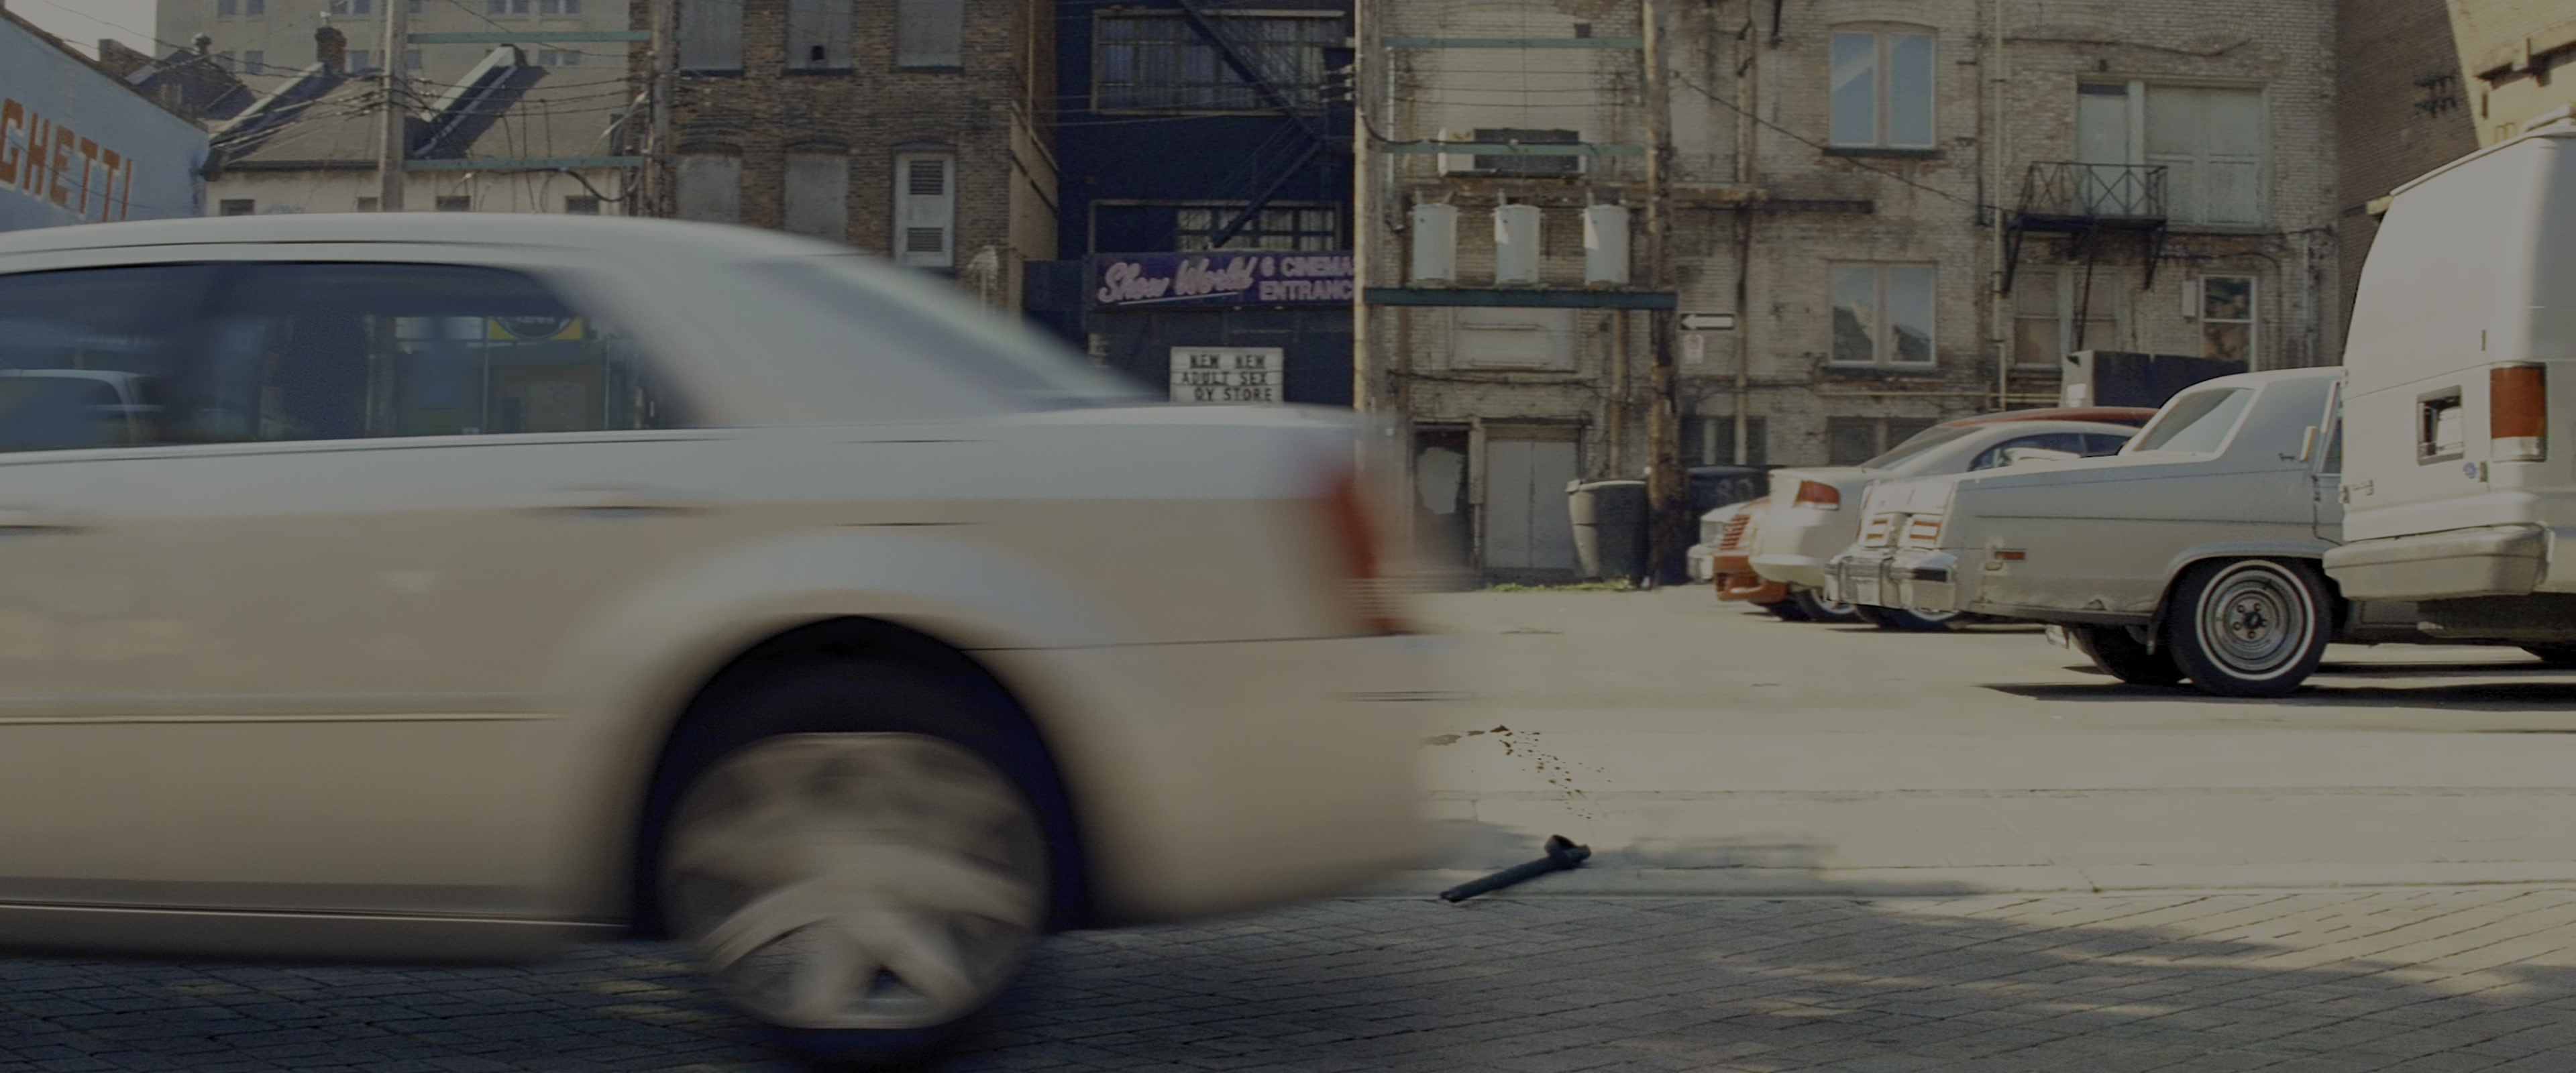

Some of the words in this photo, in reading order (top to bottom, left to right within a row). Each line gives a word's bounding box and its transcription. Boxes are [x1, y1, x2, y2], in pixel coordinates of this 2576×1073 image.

[1097, 262, 1170, 302] Show
[1175, 256, 1258, 295] World
[1258, 280, 1354, 301] ENTRANC
[1182, 372, 1230, 386] ADULT
[1240, 372, 1268, 386] SEX
[1224, 387, 1273, 401] STORE
